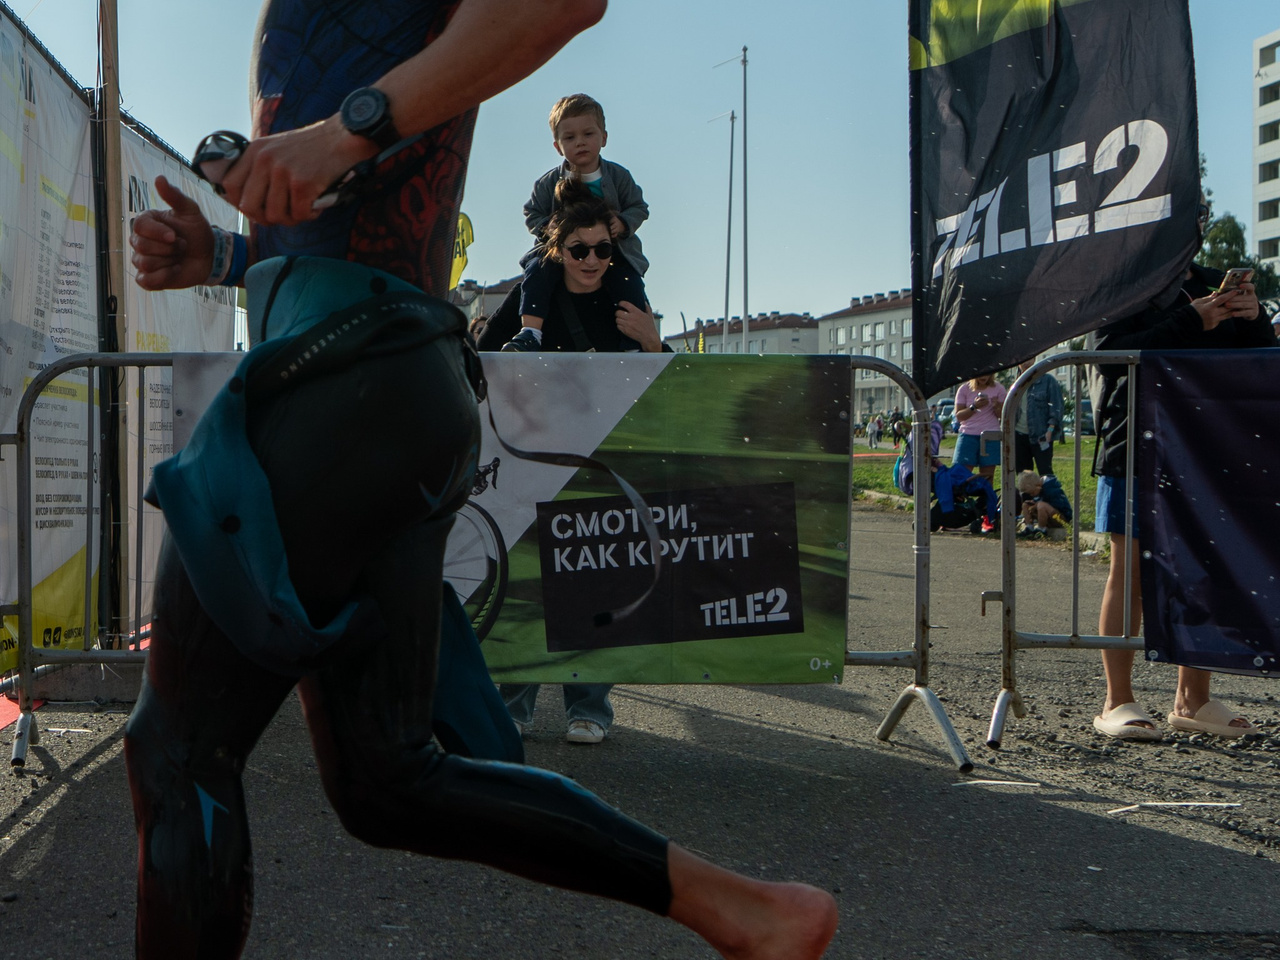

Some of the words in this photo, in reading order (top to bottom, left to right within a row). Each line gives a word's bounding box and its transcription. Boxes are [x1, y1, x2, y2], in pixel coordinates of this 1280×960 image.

[932, 119, 1172, 280] TELE2
[550, 503, 698, 540] СМОТРИ,
[553, 543, 620, 573] КАК
[628, 532, 755, 568] КРУТИТ
[700, 587, 790, 628] TELE2
[809, 657, 832, 672] 0+
